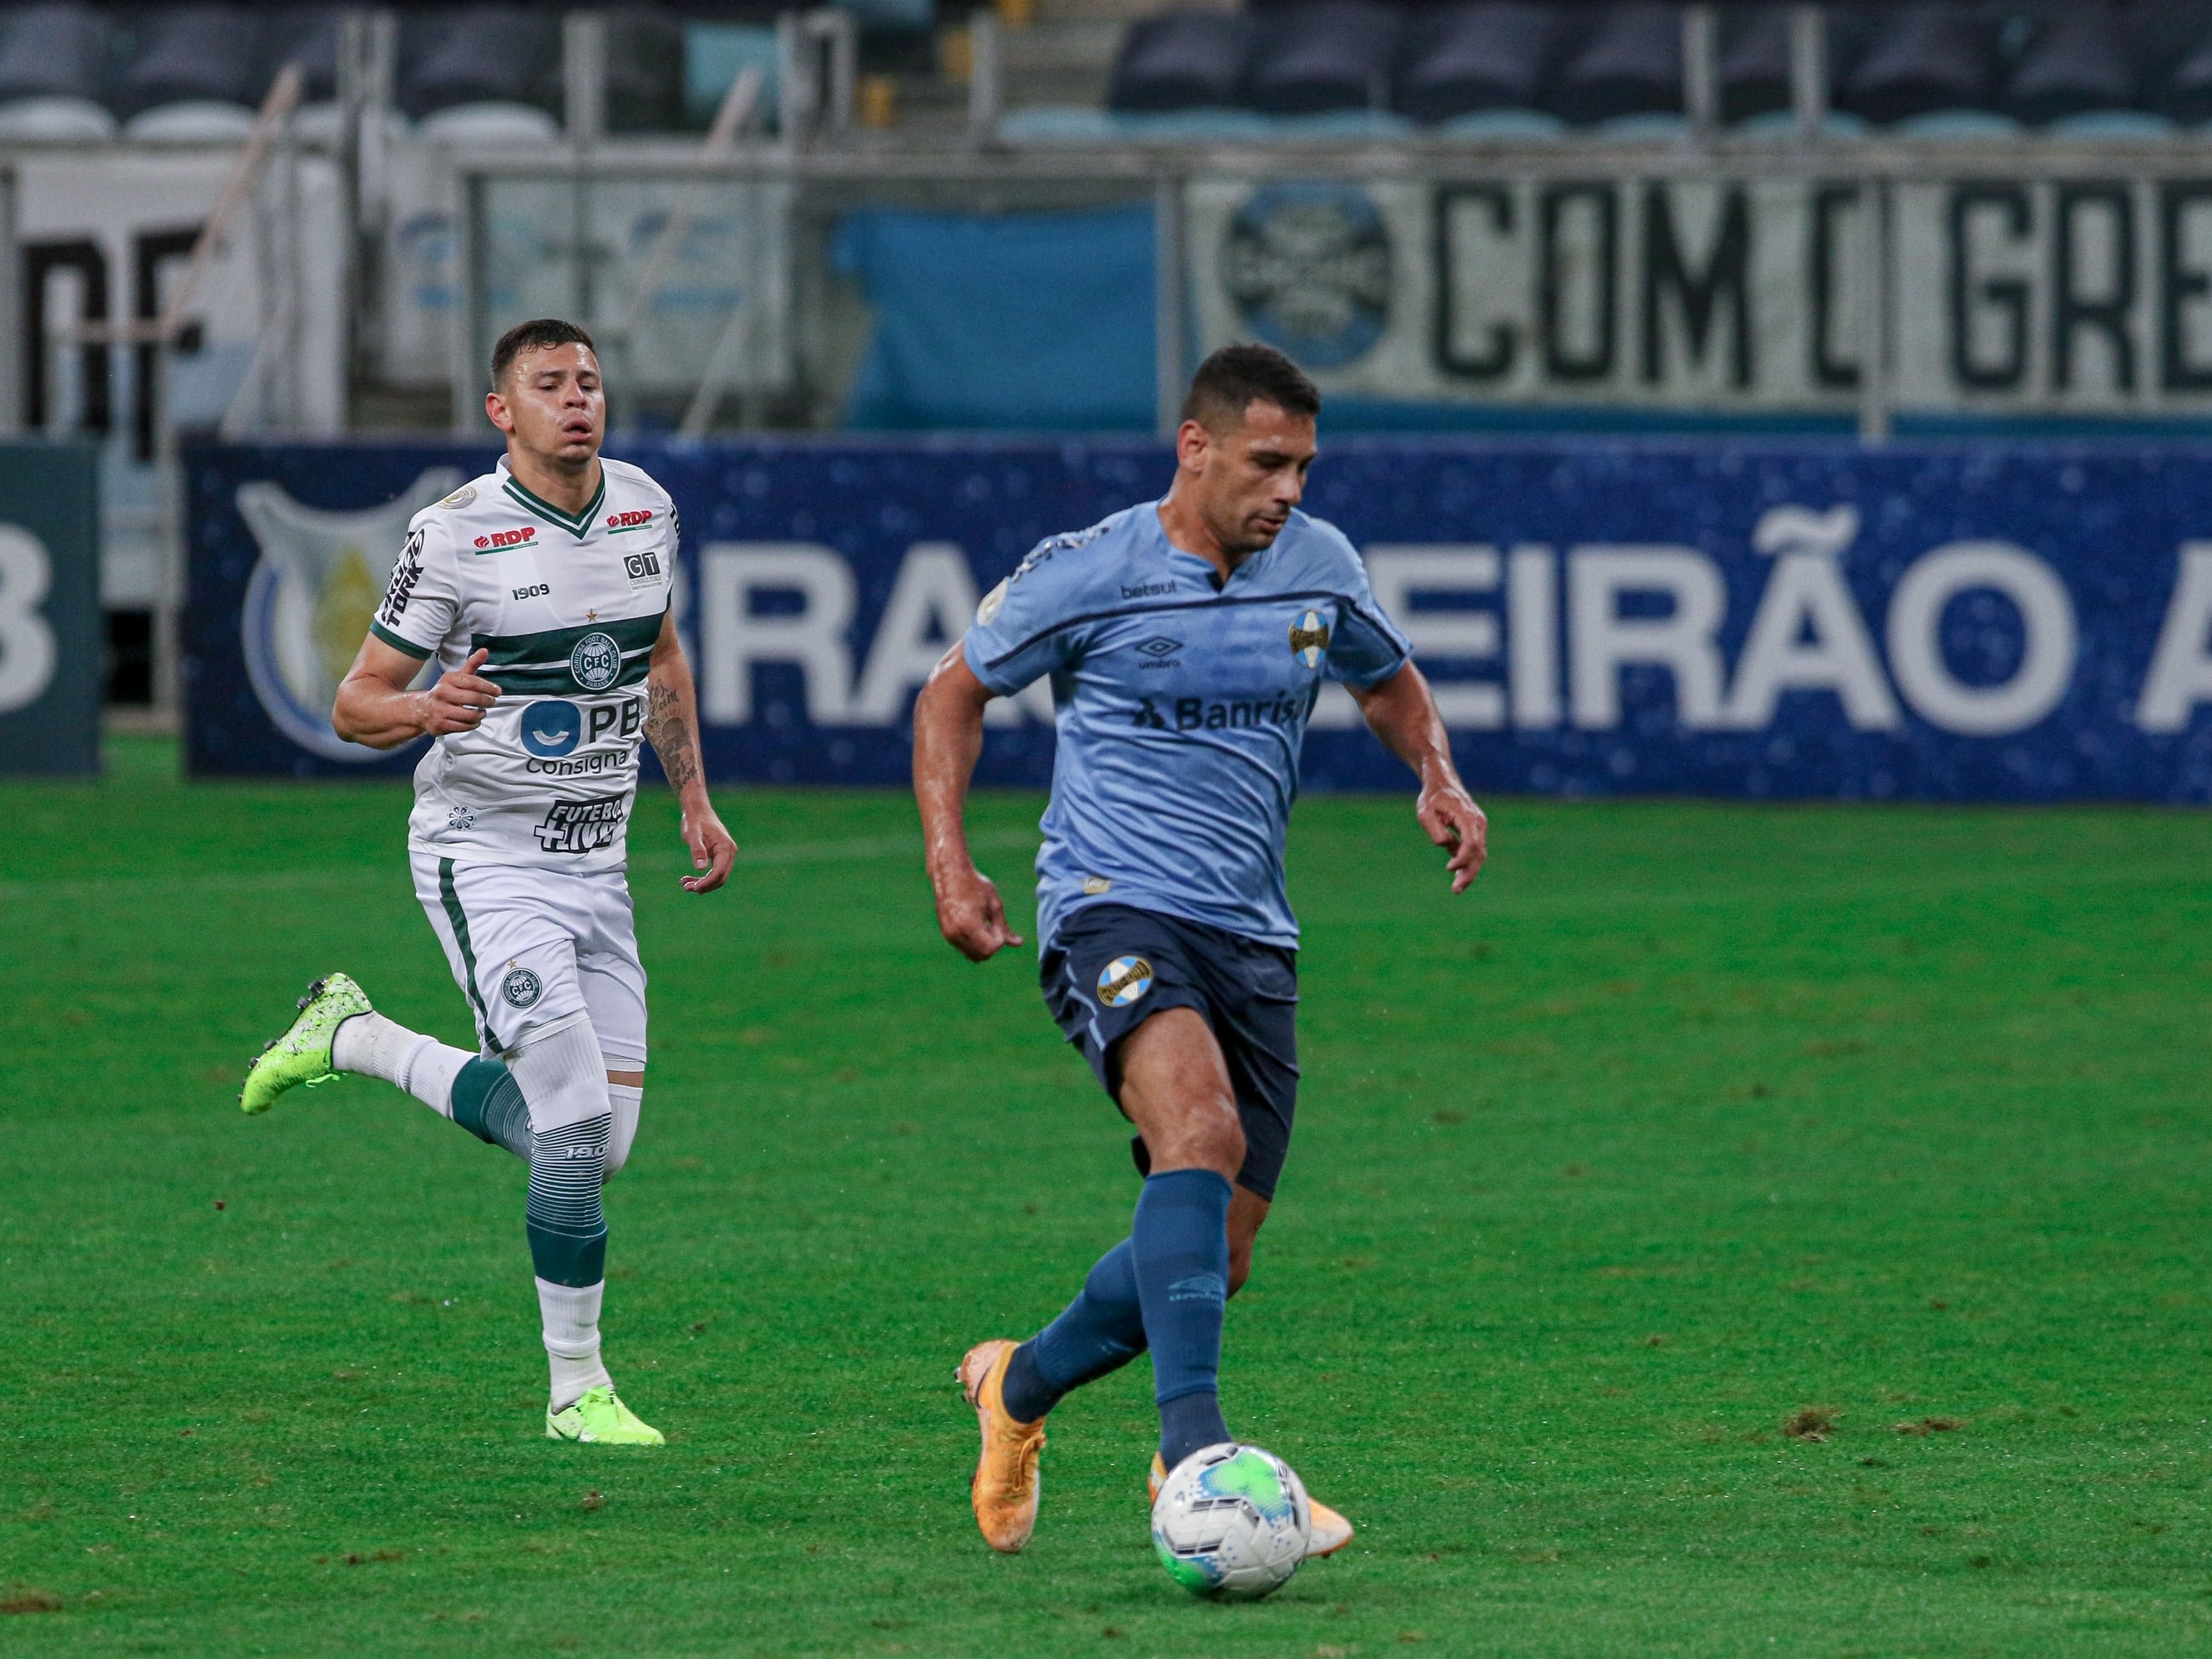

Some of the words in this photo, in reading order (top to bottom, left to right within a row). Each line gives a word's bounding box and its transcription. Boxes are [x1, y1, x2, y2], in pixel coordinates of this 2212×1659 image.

[1430, 179, 1754, 387] COM
[619, 509, 652, 527] RDP
[490, 526, 536, 548] RDP
[625, 552, 659, 578] GT
[385, 560, 425, 627] TORK
[512, 583, 550, 601] 1909
[1120, 580, 1177, 601] betsul
[584, 655, 609, 670] CFC
[588, 695, 640, 744] PB
[512, 980, 532, 996] CFC
